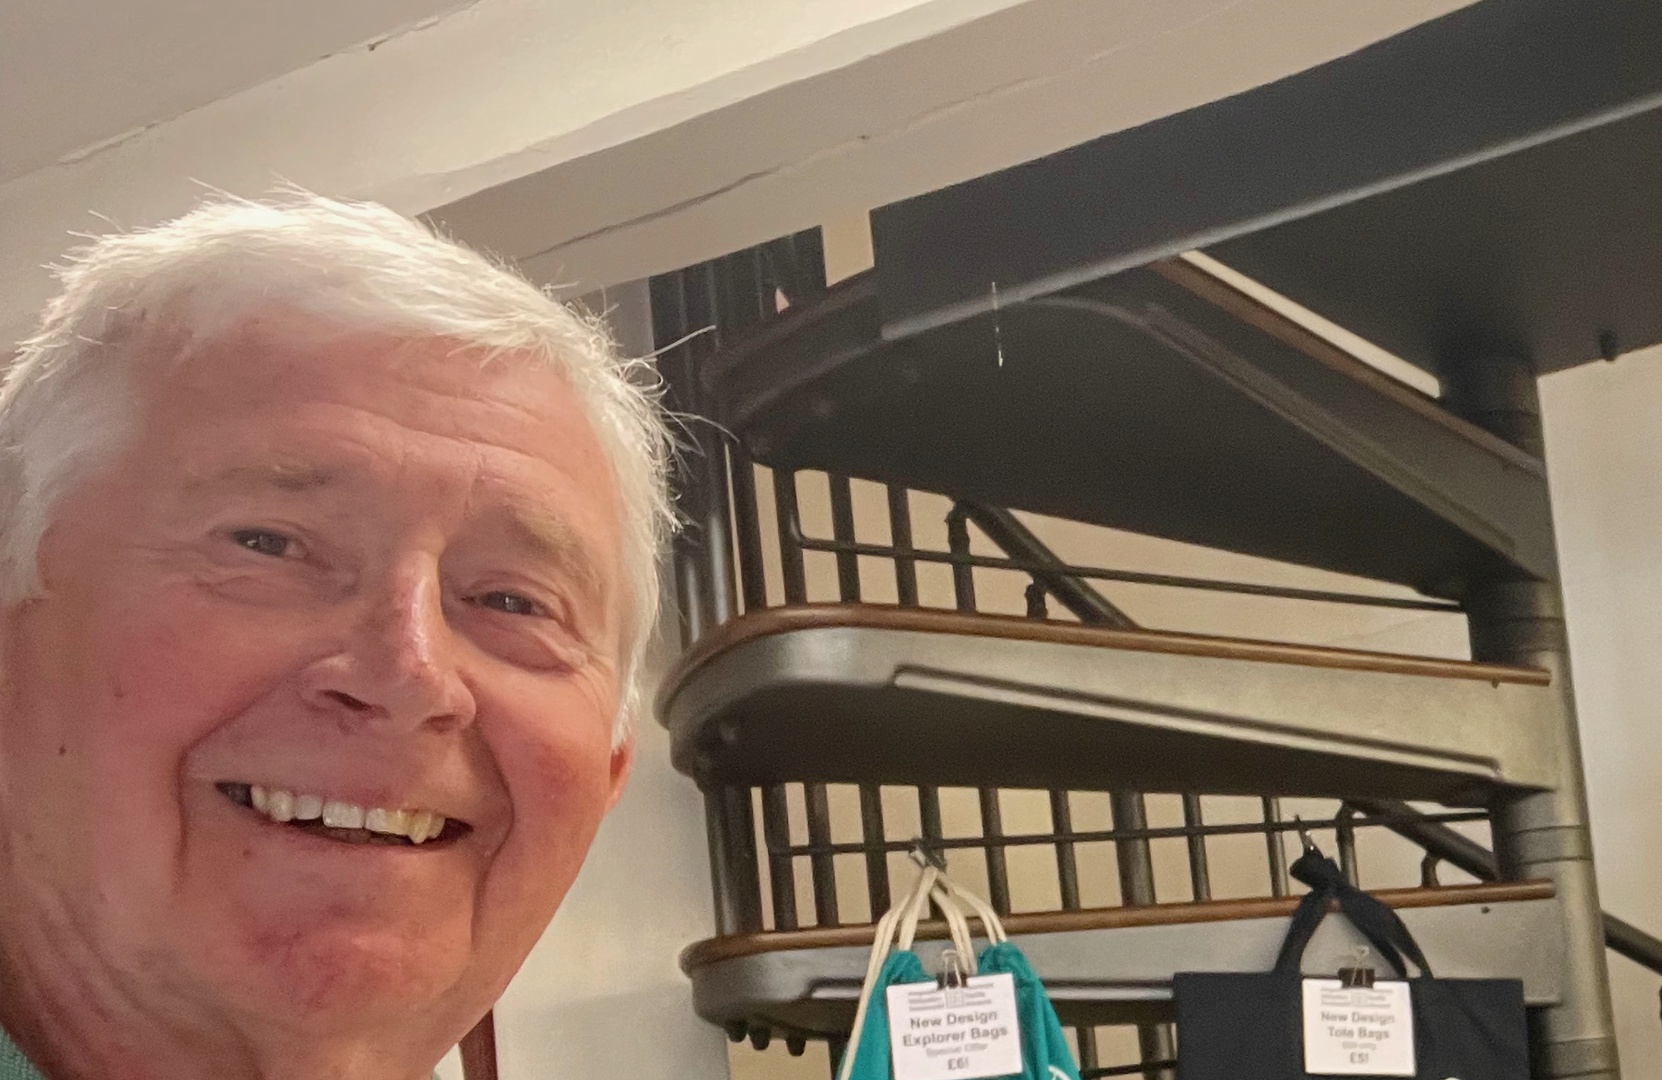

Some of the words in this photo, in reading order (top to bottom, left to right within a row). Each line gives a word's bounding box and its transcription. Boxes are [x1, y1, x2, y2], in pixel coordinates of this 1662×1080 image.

[910, 1017, 942, 1029] New
[947, 1011, 998, 1025] Design
[1321, 1011, 1348, 1021] New
[903, 1030, 965, 1047] Explorer
[971, 1026, 1008, 1040] Bags
[1358, 1027, 1390, 1041] Bags
